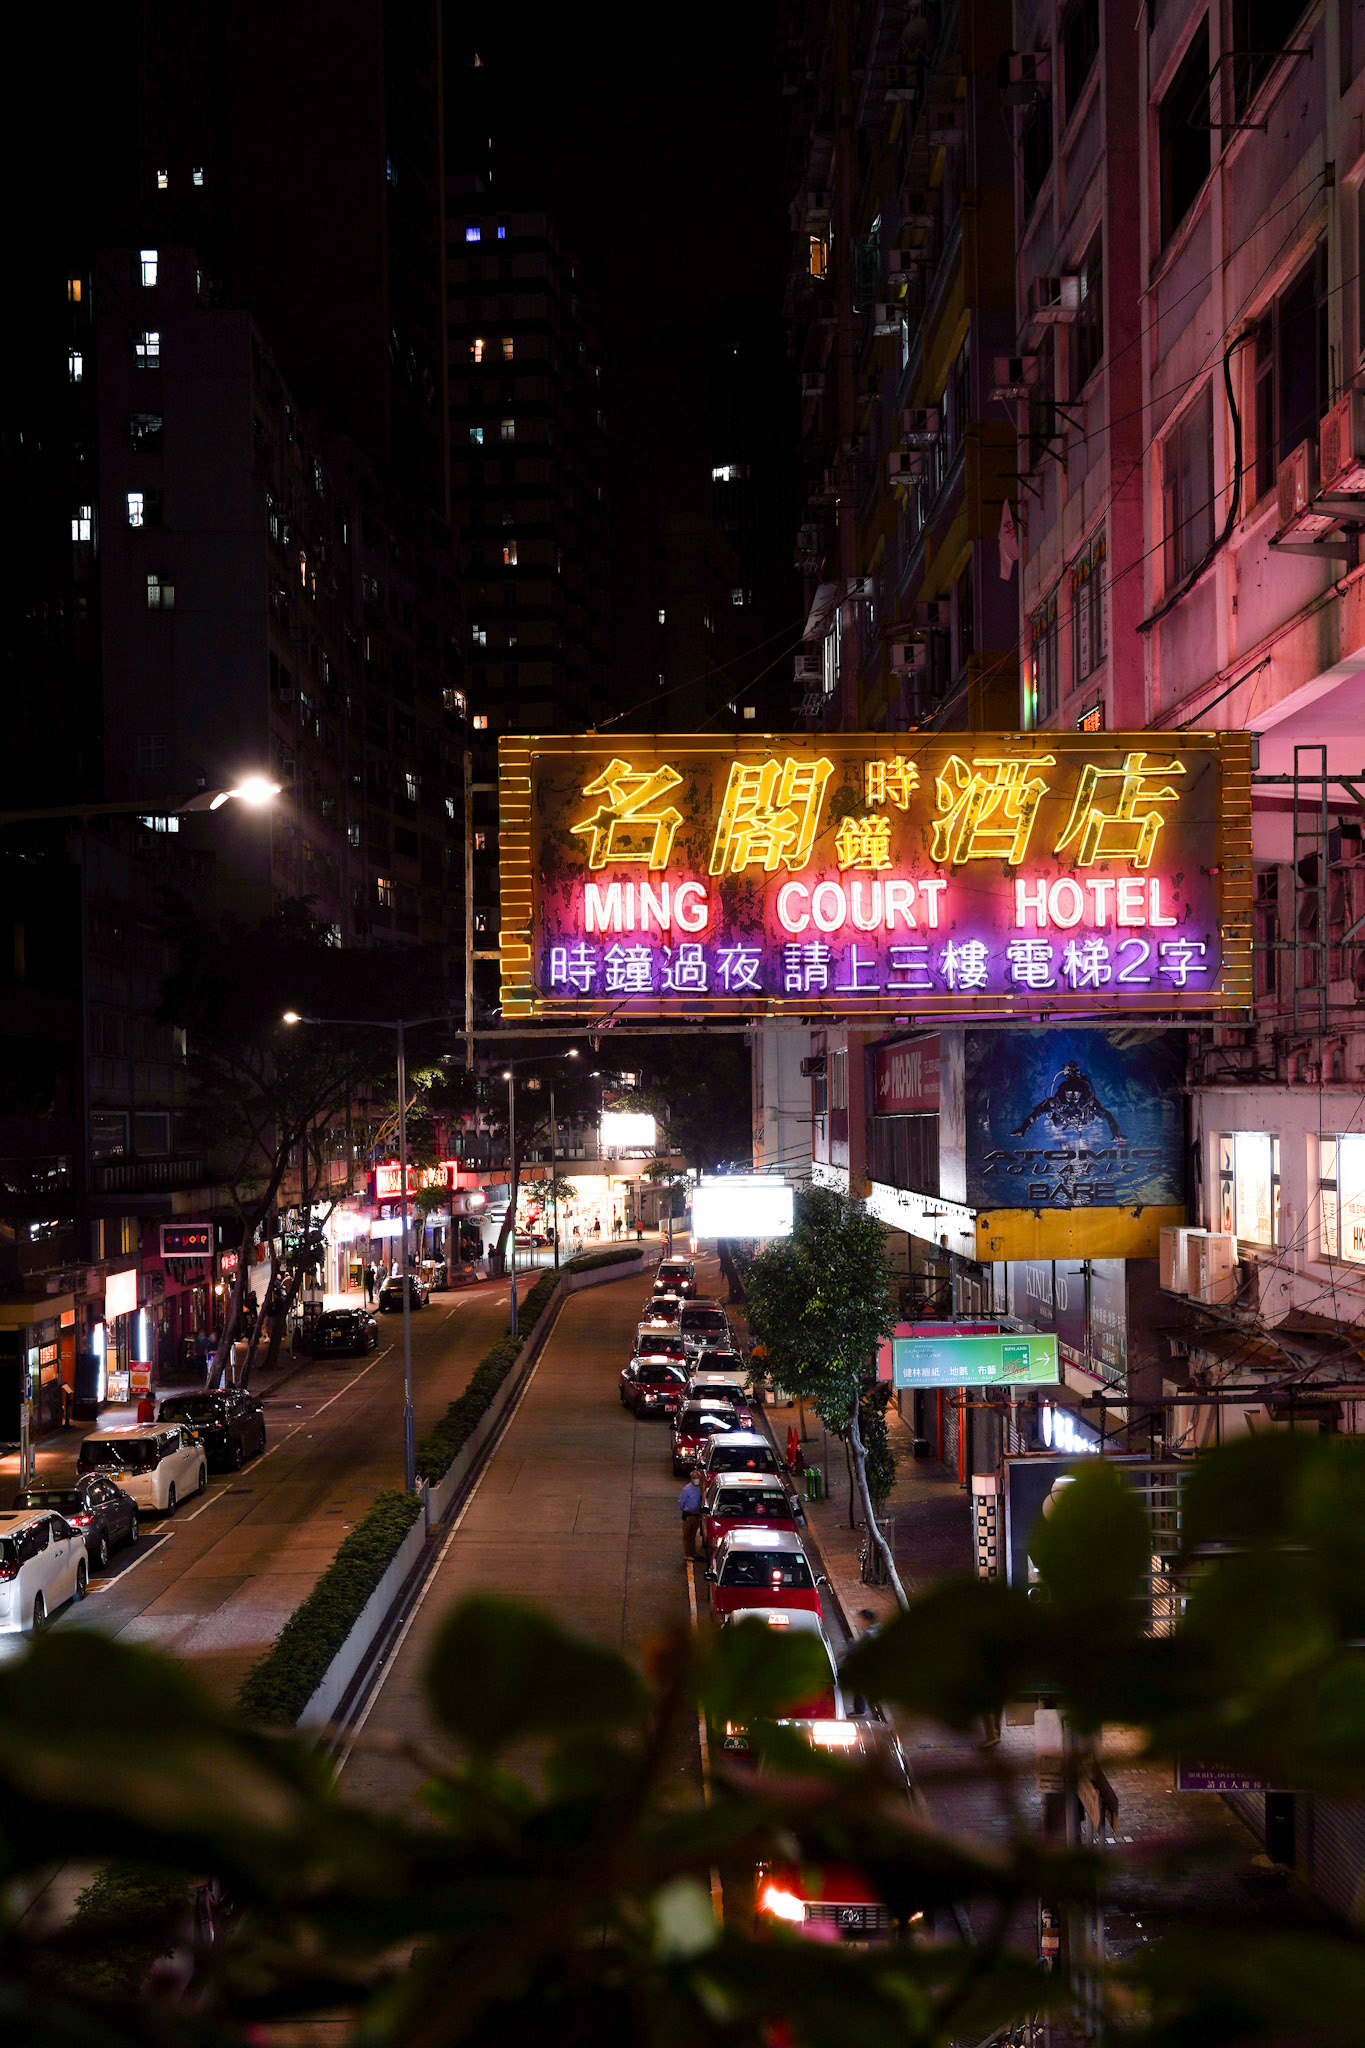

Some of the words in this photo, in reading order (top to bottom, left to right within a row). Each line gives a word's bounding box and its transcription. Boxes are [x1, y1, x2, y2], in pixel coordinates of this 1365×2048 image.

[583, 881, 709, 934] MING
[776, 878, 948, 934] COURT
[1014, 876, 1178, 929] HOTEL
[549, 943, 763, 994] 時鐘過夜
[784, 939, 990, 994] 請上三樓
[1006, 936, 1209, 990] 電梯2字
[891, 1051, 922, 1100] PRO-DIVE
[982, 1163, 1165, 1176] AQUATICS
[983, 1149, 1162, 1162] ATOMIC
[1028, 1183, 1116, 1201] BARE
[166, 1233, 208, 1247] coyote
[1025, 1264, 1069, 1312] KINLAND
